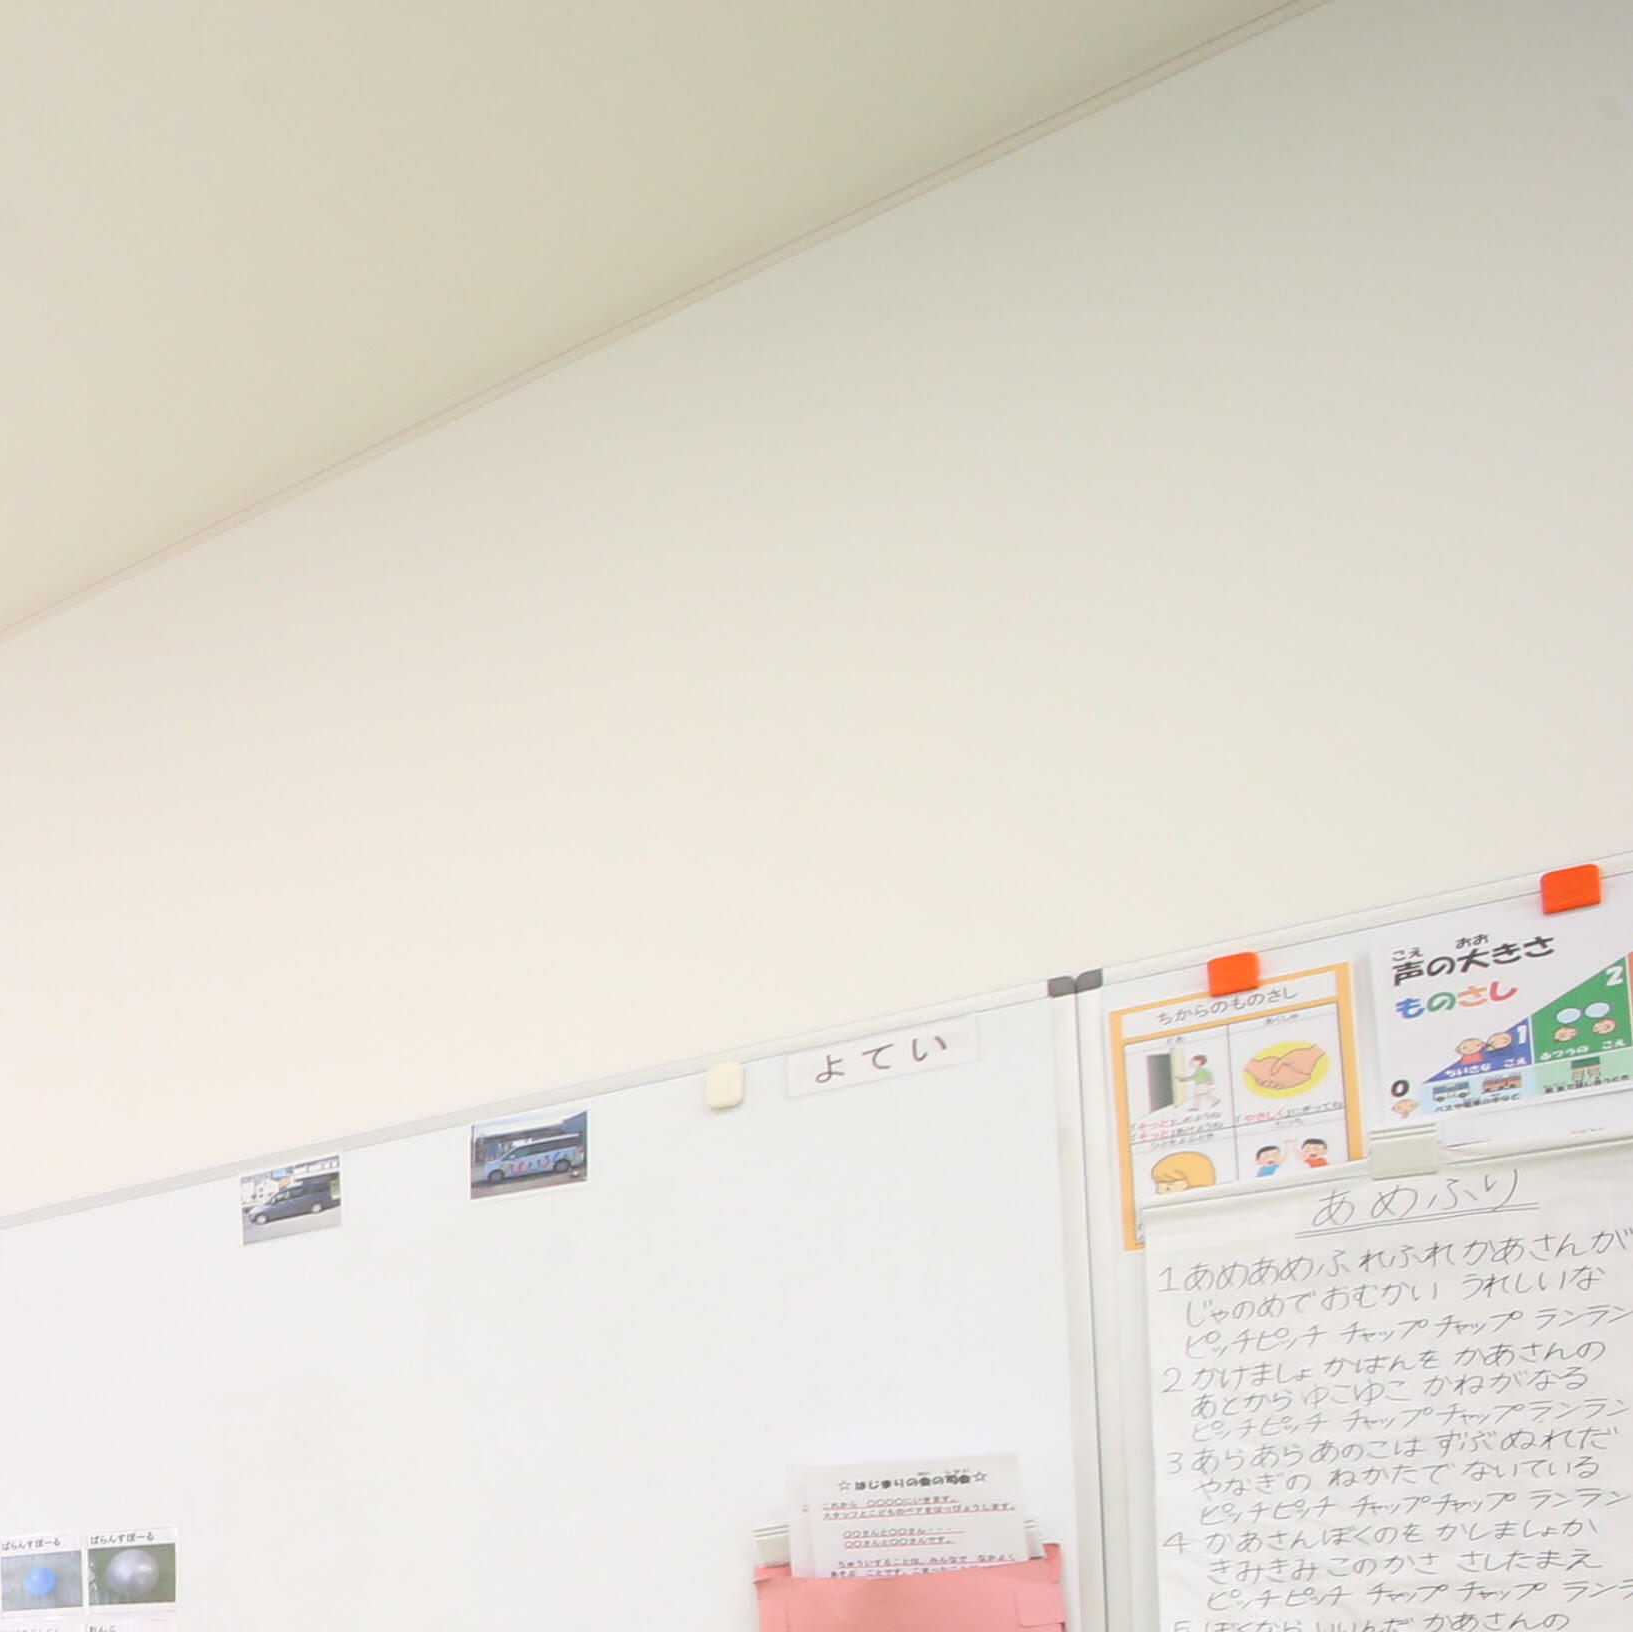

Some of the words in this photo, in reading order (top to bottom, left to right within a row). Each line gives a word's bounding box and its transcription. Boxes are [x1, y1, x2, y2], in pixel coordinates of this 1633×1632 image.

[1392, 936, 1555, 987] 声の大きさ
[1605, 965, 1624, 987] 2
[1157, 987, 1299, 1026] ちからのものさし
[1395, 981, 1519, 1019] ものさし
[1516, 1024, 1527, 1045] 1
[815, 1036, 948, 1085] よてい
[1390, 1079, 1410, 1098] 0
[1311, 1168, 1519, 1228] あめふり
